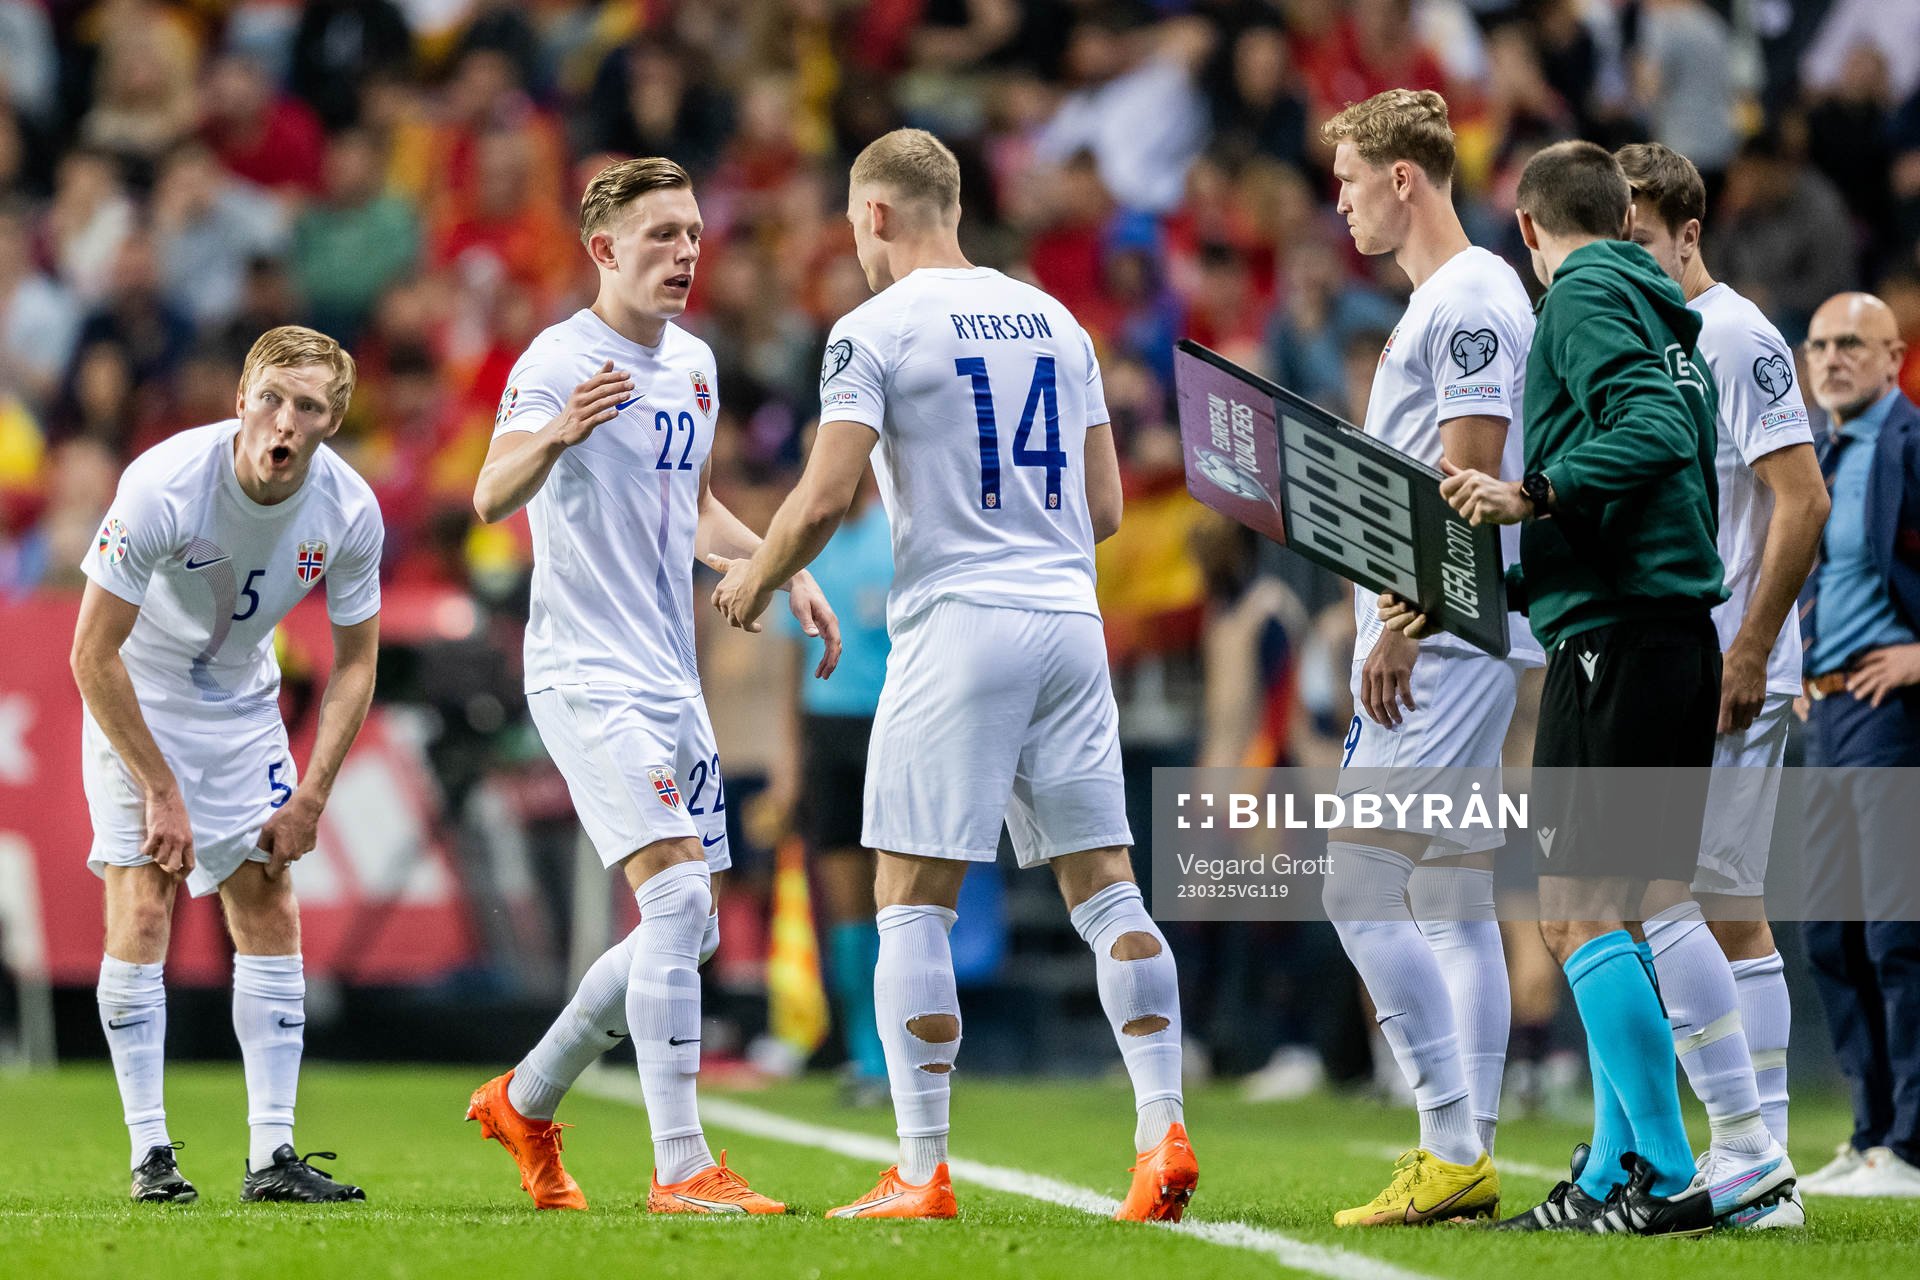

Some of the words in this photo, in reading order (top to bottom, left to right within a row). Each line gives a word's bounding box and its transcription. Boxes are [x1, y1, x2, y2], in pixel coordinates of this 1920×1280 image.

[950, 313, 1053, 340] RYERSON
[1208, 392, 1231, 453] EUROPEAN
[1444, 386, 1501, 398] FOUNDATION
[654, 410, 695, 471] 22
[954, 356, 1067, 510] 14
[1230, 399, 1261, 473] QUALIFIERS
[231, 569, 266, 621] 5
[1441, 519, 1480, 619] UEFA.com
[1342, 715, 1363, 772] 9
[268, 761, 292, 809] 5
[687, 753, 725, 816] 22
